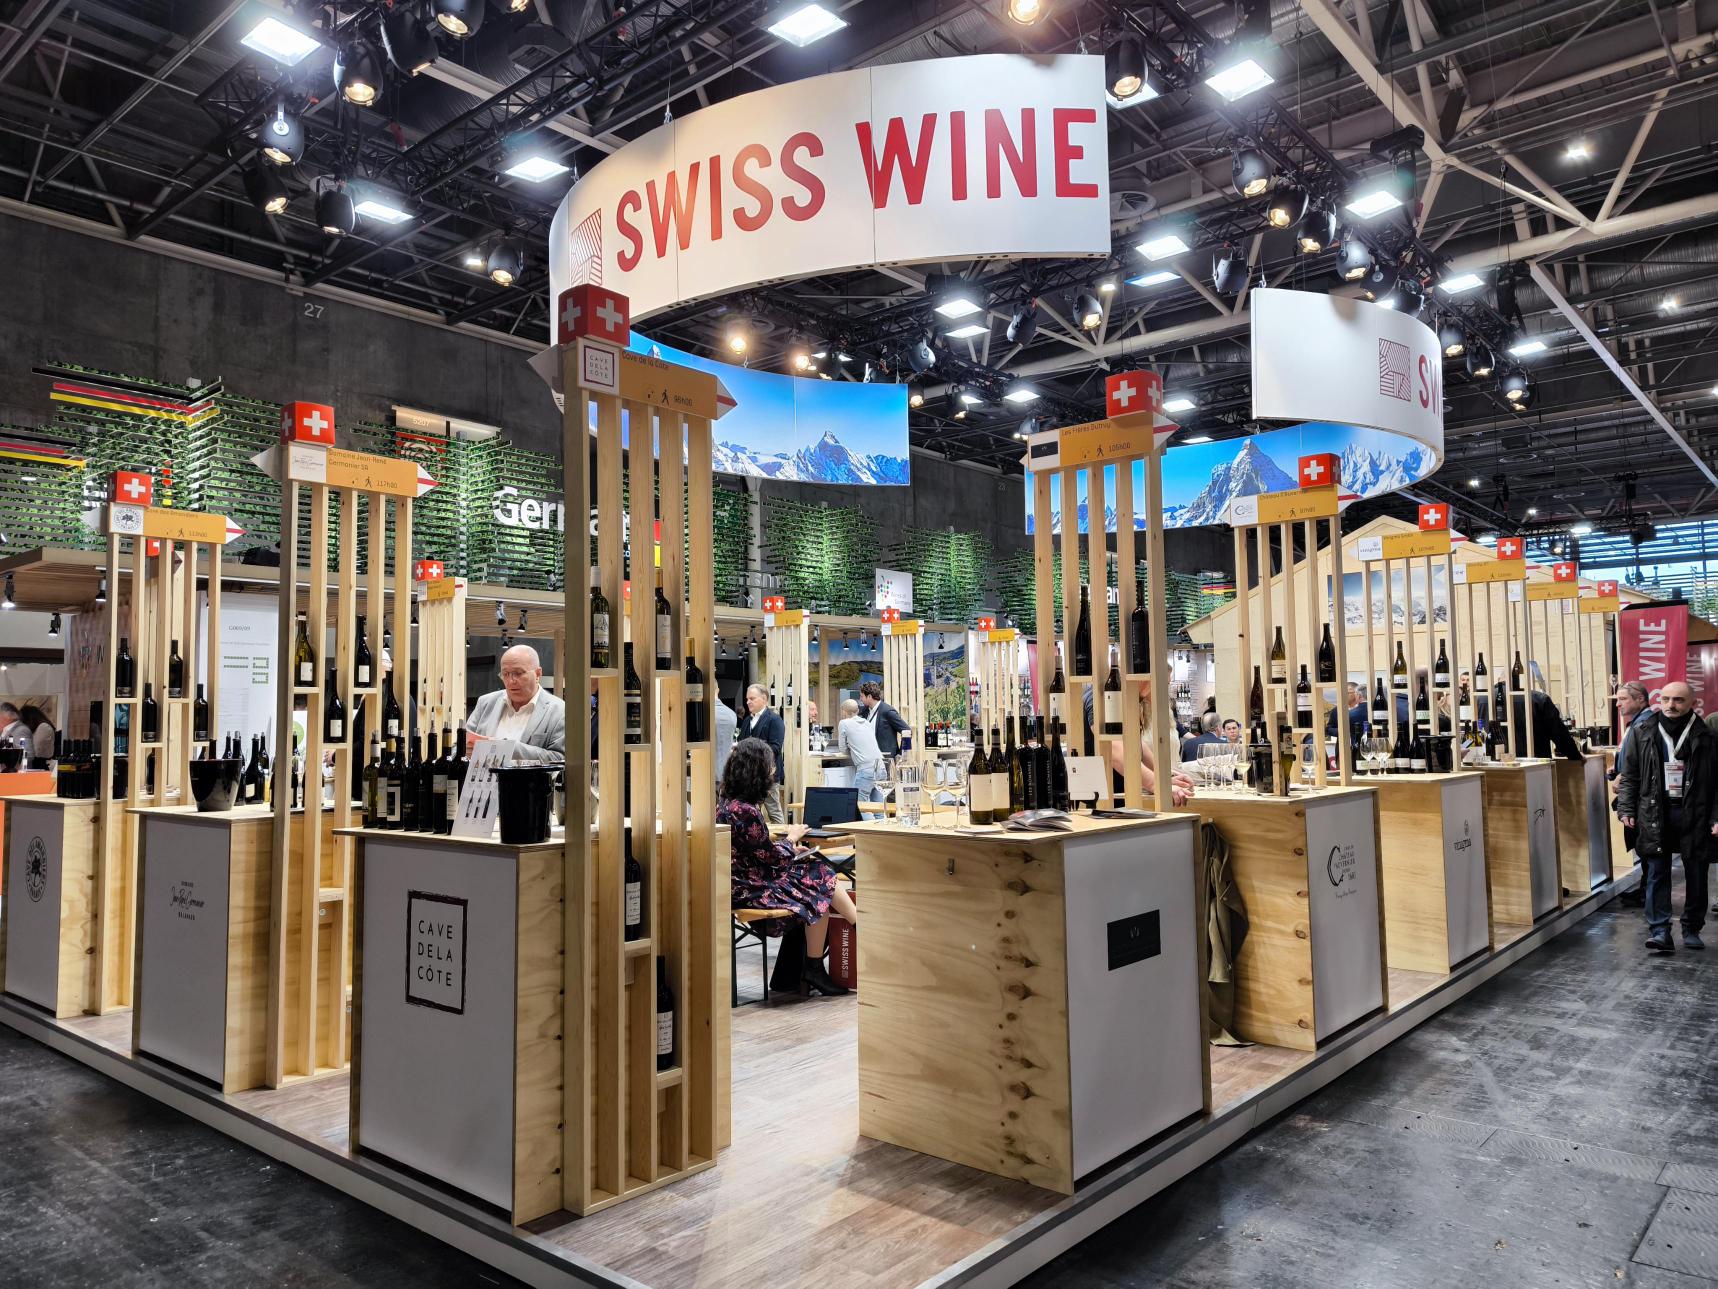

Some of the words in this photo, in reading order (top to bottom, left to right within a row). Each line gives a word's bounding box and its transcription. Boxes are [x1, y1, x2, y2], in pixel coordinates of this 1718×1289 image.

[616, 131, 827, 273] SWISS
[855, 107, 1099, 210] WINE
[304, 302, 324, 319] 27
[328, 448, 356, 460] Domaine
[328, 459, 360, 470] Germanier
[1638, 619, 1666, 681] WINE
[418, 919, 453, 940] CAVE
[841, 928, 849, 947] WINE
[841, 947, 849, 970] SWISS
[417, 964, 452, 987] CÔTE
